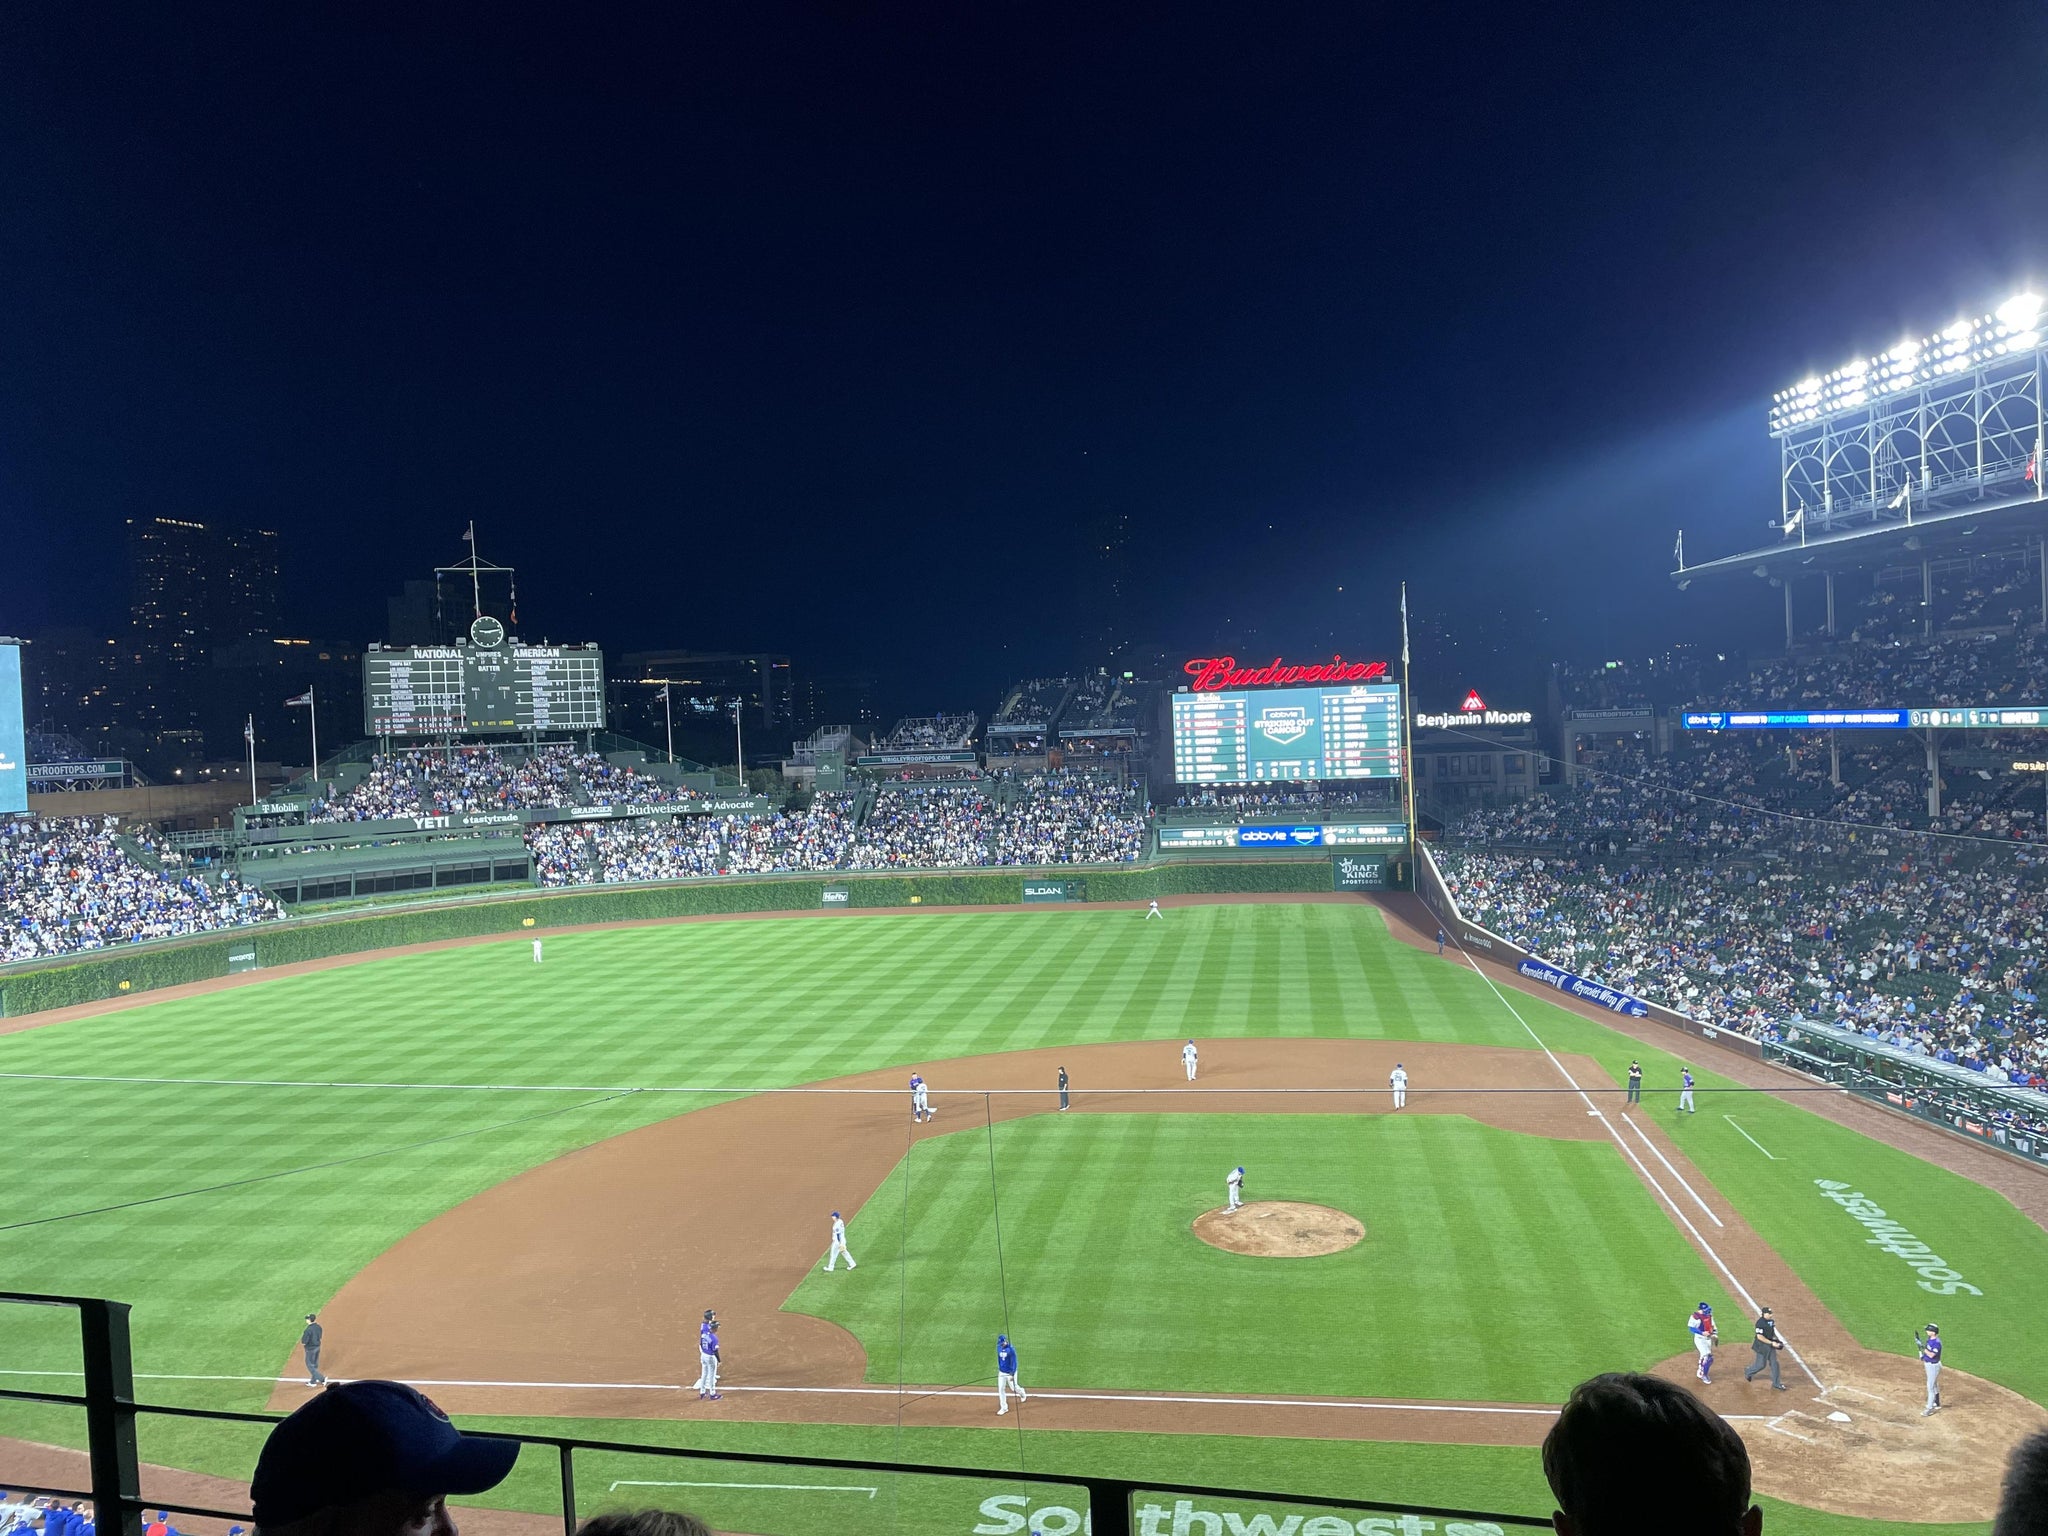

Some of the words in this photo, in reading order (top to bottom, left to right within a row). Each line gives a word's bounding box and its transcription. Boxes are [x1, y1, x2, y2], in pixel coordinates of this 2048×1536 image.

[414, 649, 464, 659] NATIONAL
[513, 649, 560, 658] AMERICAN
[1184, 655, 1387, 691] Budweiser
[1296, 718, 1315, 727] OUT
[1416, 711, 1482, 729] Benjamin
[1485, 711, 1531, 725] Moore
[270, 803, 299, 813] Mobile
[714, 800, 755, 810] Advocate
[571, 806, 613, 815] GRAINGER
[413, 816, 450, 829] YETI
[470, 813, 519, 824] tastytrade
[1241, 831, 1287, 840] abbvie
[1342, 864, 1380, 873] DRAFT
[1346, 871, 1379, 879] KINGS
[1520, 963, 1544, 981] Reynolds
[1543, 969, 1558, 985] Wrap
[1572, 980, 1600, 999] Reynolds
[1599, 990, 1618, 1006] Wrap
[1820, 1190, 1984, 1296] Southwest
[973, 1494, 1433, 1536] Sothwest
